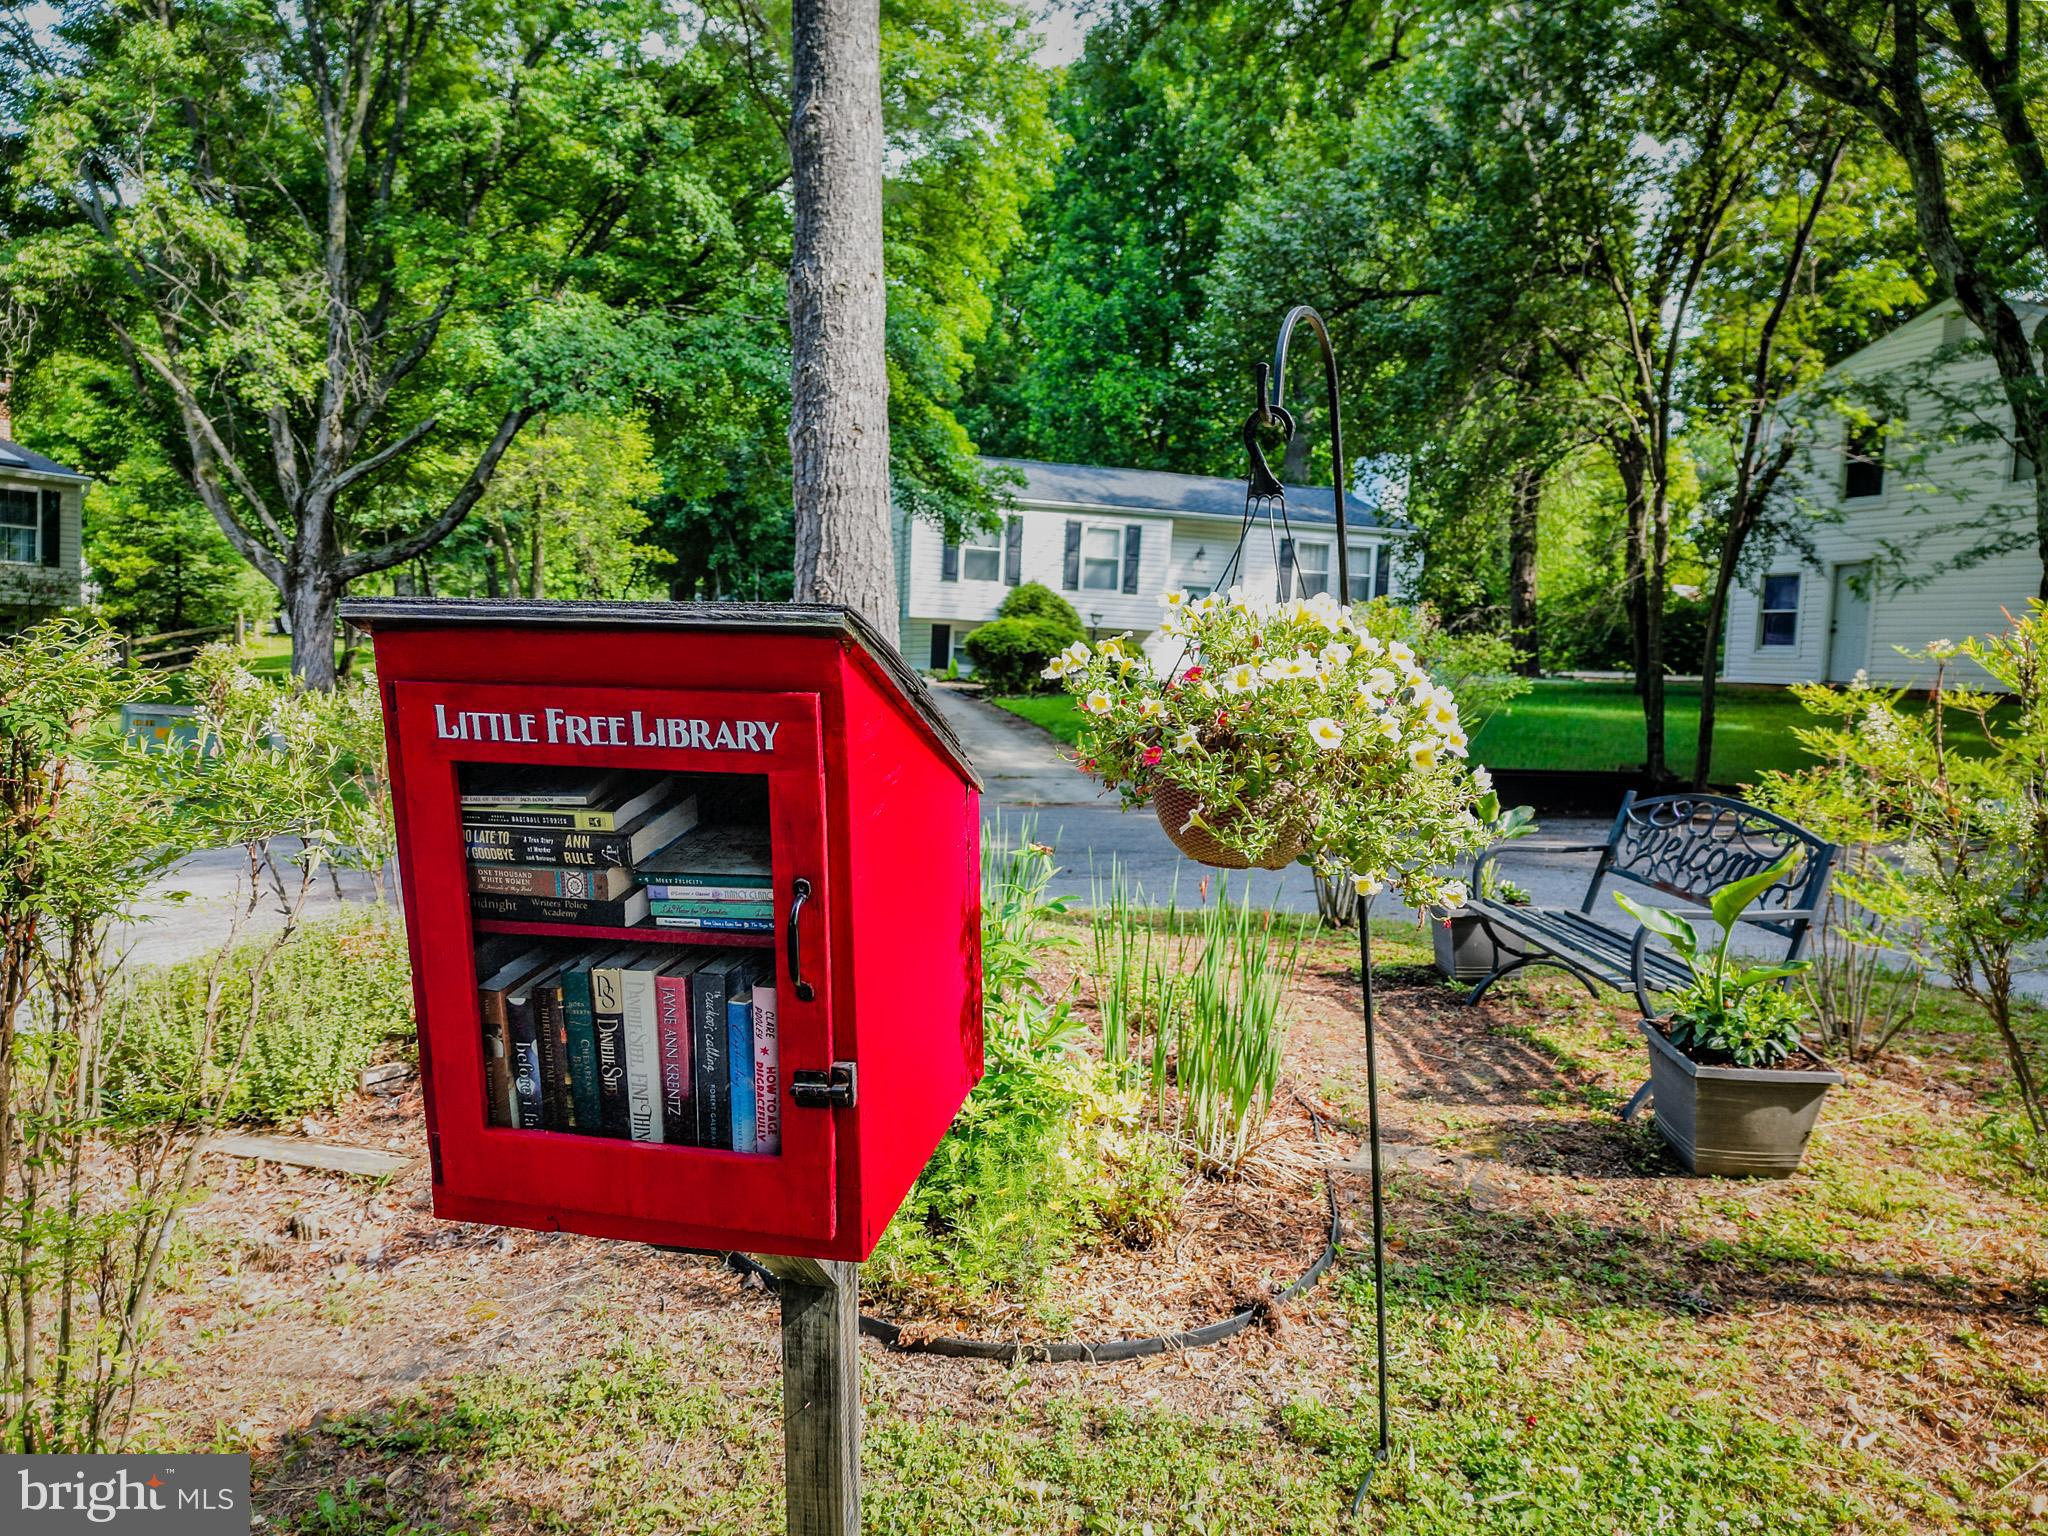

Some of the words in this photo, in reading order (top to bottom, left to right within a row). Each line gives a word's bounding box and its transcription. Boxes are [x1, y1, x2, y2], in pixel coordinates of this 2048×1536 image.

[434, 704, 539, 743] LITTLE
[545, 707, 628, 747] FREE
[631, 710, 780, 752] LIBRARY
[463, 829, 473, 843] O
[474, 829, 497, 844] LATE
[497, 830, 510, 845] TO
[564, 834, 591, 849] ANN
[471, 846, 517, 861] GOODBYE
[563, 851, 597, 865] RULE
[1624, 824, 1778, 884] Welcom
[477, 868, 493, 877] ONE
[494, 869, 533, 879] THOUSAND
[480, 876, 503, 884] WHITE
[505, 877, 531, 886] WOMEN
[542, 908, 578, 920] Academy
[564, 900, 589, 910] Police
[624, 981, 646, 1032] DANIELLE
[660, 986, 677, 1025] JAYNE
[754, 1006, 764, 1040] POOLEY
[765, 1010, 775, 1039] CLARE
[597, 1018, 619, 1065] DANIELLE
[628, 1031, 651, 1067] STEEL
[664, 1028, 679, 1059] ANN
[702, 1033, 720, 1073] calling
[515, 1042, 535, 1095] before
[766, 1066, 777, 1095] HOW
[631, 1073, 650, 1104] FINE
[666, 1063, 681, 1116] KRENTZ
[709, 1084, 717, 1110] ROBERT
[756, 1061, 766, 1142] DISGRACEFULLY
[766, 1098, 777, 1113] TO
[632, 1103, 653, 1141] THIN
[767, 1115, 778, 1135] AGE
